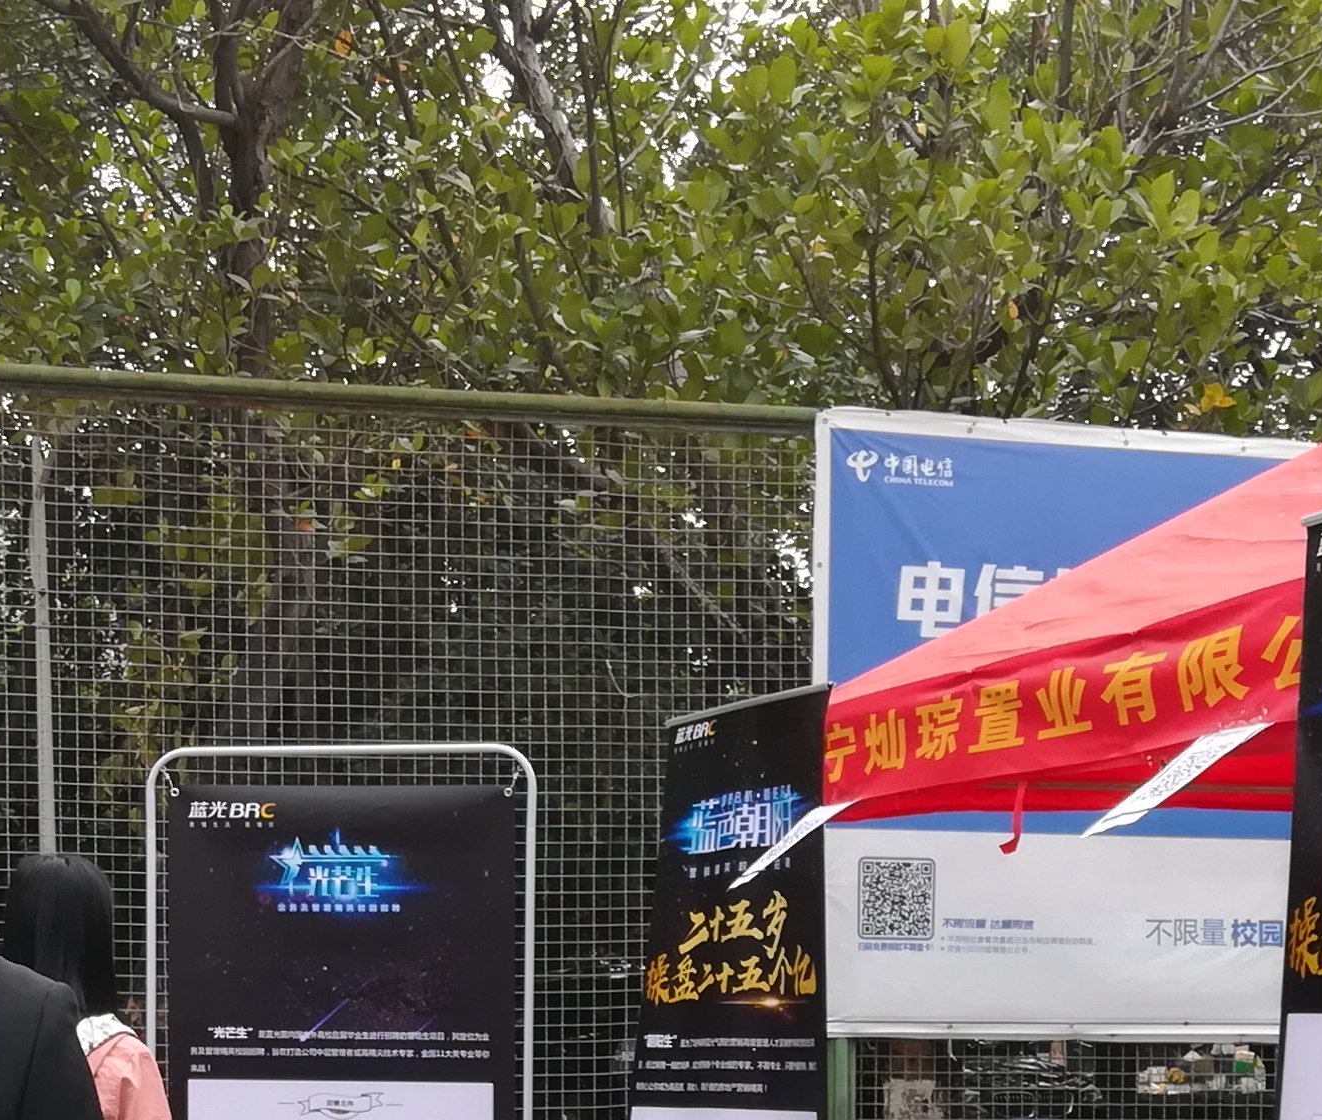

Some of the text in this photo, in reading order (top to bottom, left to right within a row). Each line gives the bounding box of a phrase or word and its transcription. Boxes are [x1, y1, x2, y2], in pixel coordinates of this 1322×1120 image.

[883, 452, 954, 478] 中国电信
[883, 475, 954, 488] CHINA TELECOM
[896, 561, 1071, 638] 电信
[188, 801, 276, 819] 蓝光BRC
[678, 890, 789, 959] 二十五岁
[645, 944, 817, 1006] 操盘二十五个亿
